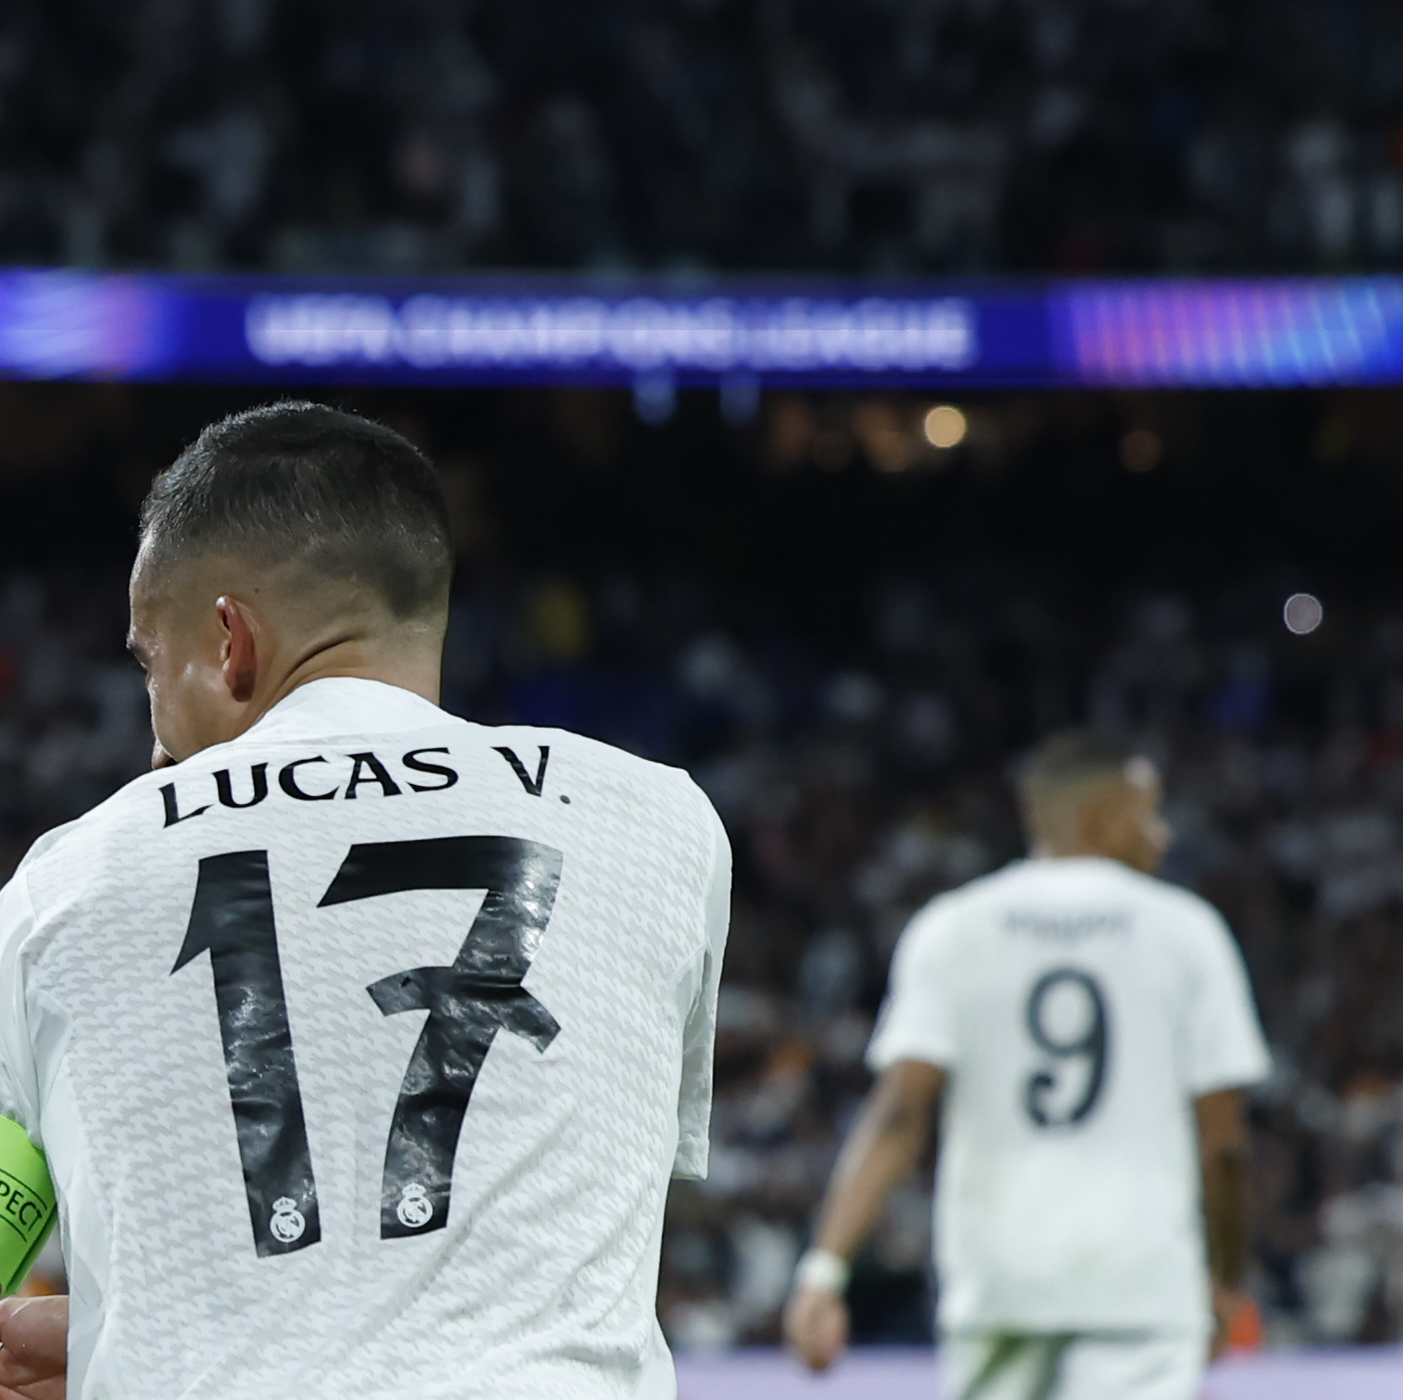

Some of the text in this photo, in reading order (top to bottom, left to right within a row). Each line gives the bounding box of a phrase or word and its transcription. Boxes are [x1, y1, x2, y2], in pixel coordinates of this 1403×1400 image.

[158, 745, 571, 829] LUCAS V.
[169, 834, 564, 1258] 17
[1025, 962, 1112, 1134] 9
